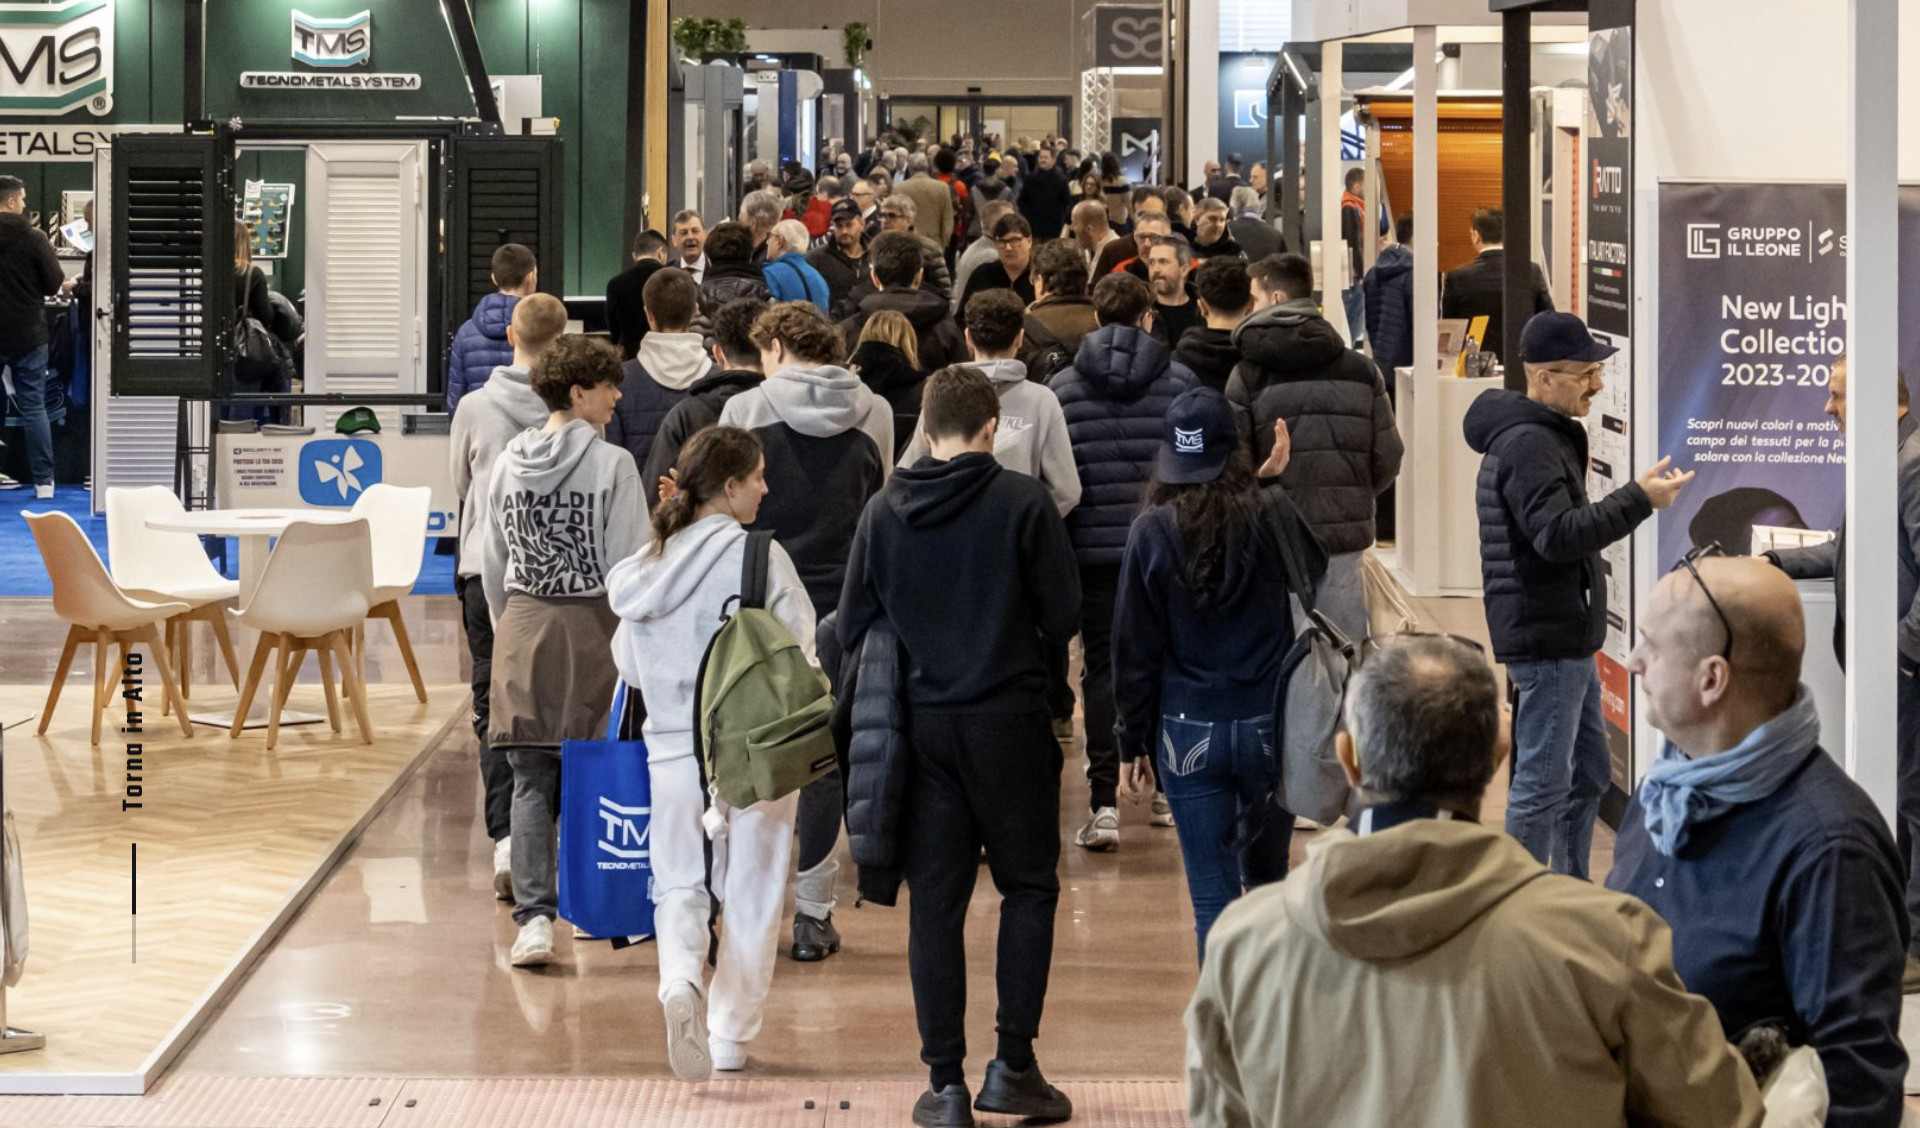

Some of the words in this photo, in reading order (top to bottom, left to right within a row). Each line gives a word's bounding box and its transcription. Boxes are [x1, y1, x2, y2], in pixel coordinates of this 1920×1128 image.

[294, 26, 365, 55] TMS
[246, 75, 415, 87] TECNOMETALSYSTEM
[1727, 227, 1801, 240] GRUPPO
[1727, 243, 1742, 256] IL
[1745, 243, 1801, 257] LEONE
[1721, 295, 1782, 320] New
[1789, 295, 1847, 328] Ligh
[1720, 328, 1844, 355] Collectio
[1721, 363, 1835, 387] 2023-20
[1686, 418, 1723, 432] Scopri
[1726, 419, 1759, 430] nuovi
[1761, 420, 1794, 431] colori
[1175, 431, 1203, 446] TMS
[1686, 436, 1726, 448] campo
[1730, 435, 1747, 446] dei
[1751, 436, 1791, 446] tessuti
[1794, 438, 1815, 449] per
[1818, 436, 1829, 447] la
[1694, 451, 1729, 462] solare
[1731, 453, 1752, 462] con
[1754, 451, 1765, 462] la
[1767, 451, 1824, 463] collezione
[503, 490, 594, 512] AMALDI
